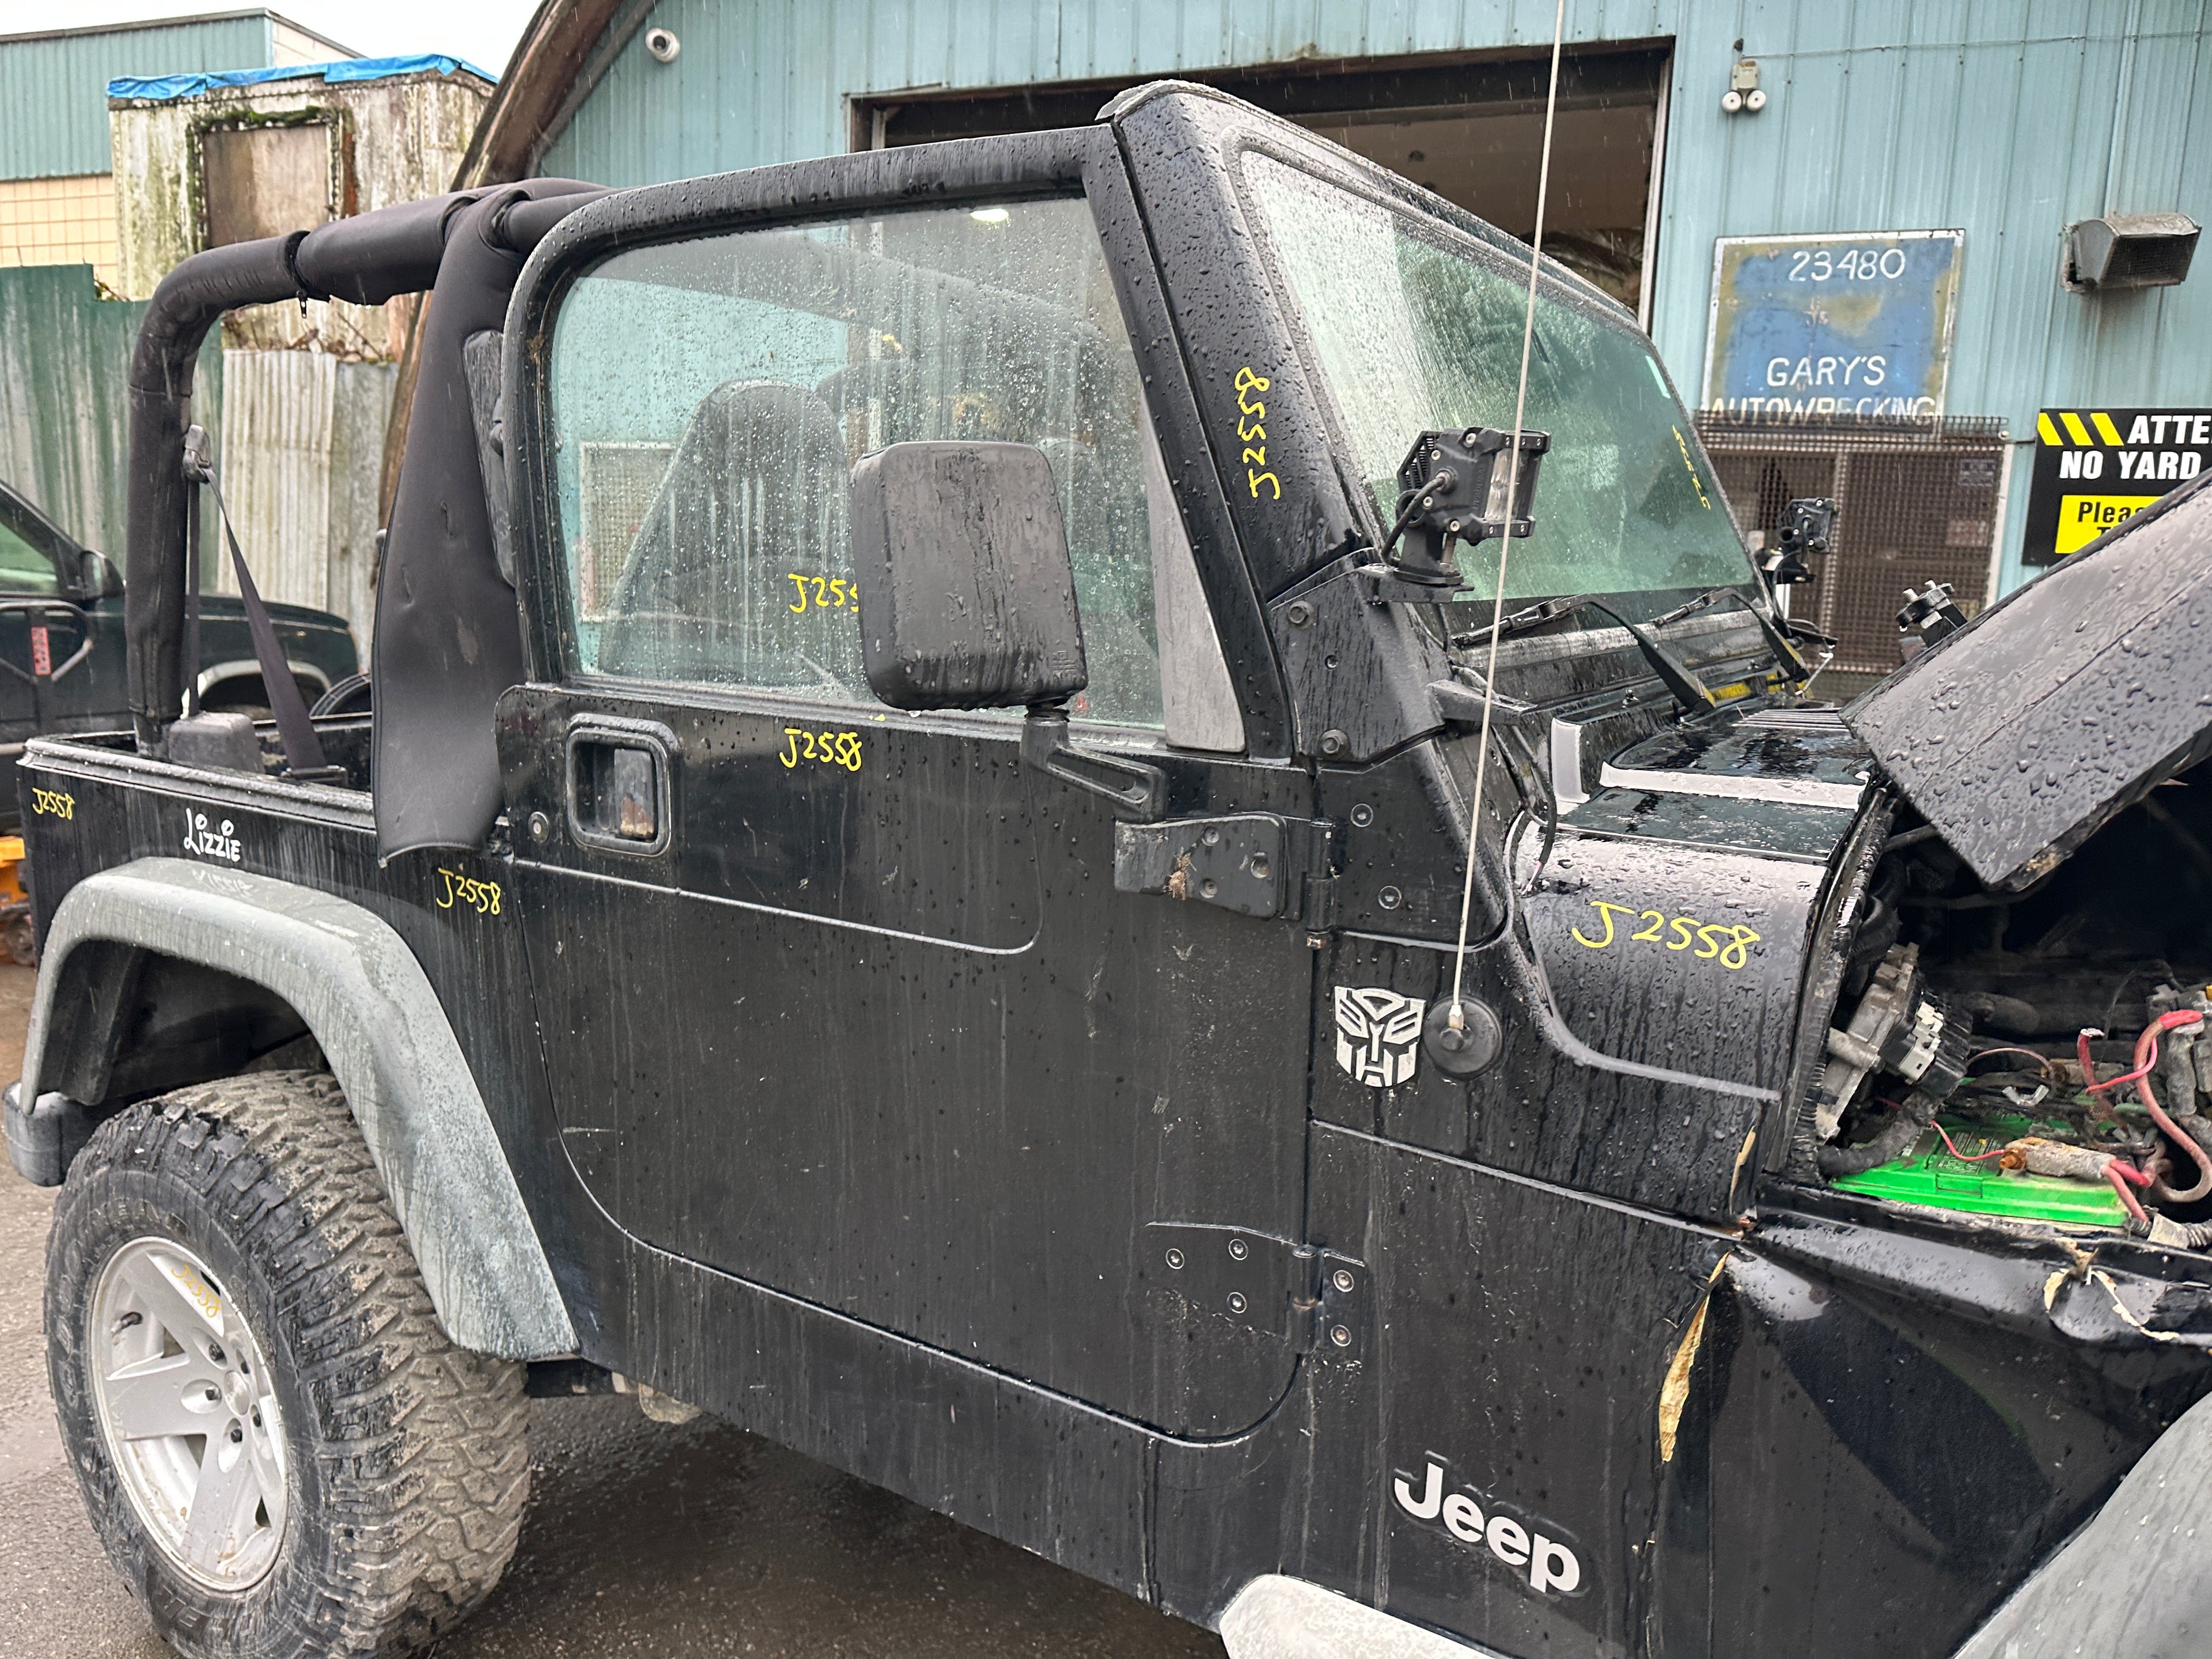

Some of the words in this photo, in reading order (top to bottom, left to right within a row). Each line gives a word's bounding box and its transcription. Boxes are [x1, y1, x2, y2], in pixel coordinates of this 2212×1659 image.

[1789, 248, 1906, 282] 23480
[1766, 355, 1887, 387] GARY'S
[1234, 367, 1281, 500] J2558
[2127, 415, 2212, 444] ATTE
[2059, 450, 2104, 479] NO
[2118, 451, 2202, 480] YARD
[779, 728, 862, 771] J2558
[32, 788, 75, 820] J2558
[437, 868, 501, 915] J2558
[1571, 900, 1760, 969] J2558
[171, 1264, 221, 1318] J2558
[1394, 1462, 1580, 1593] Jeep
